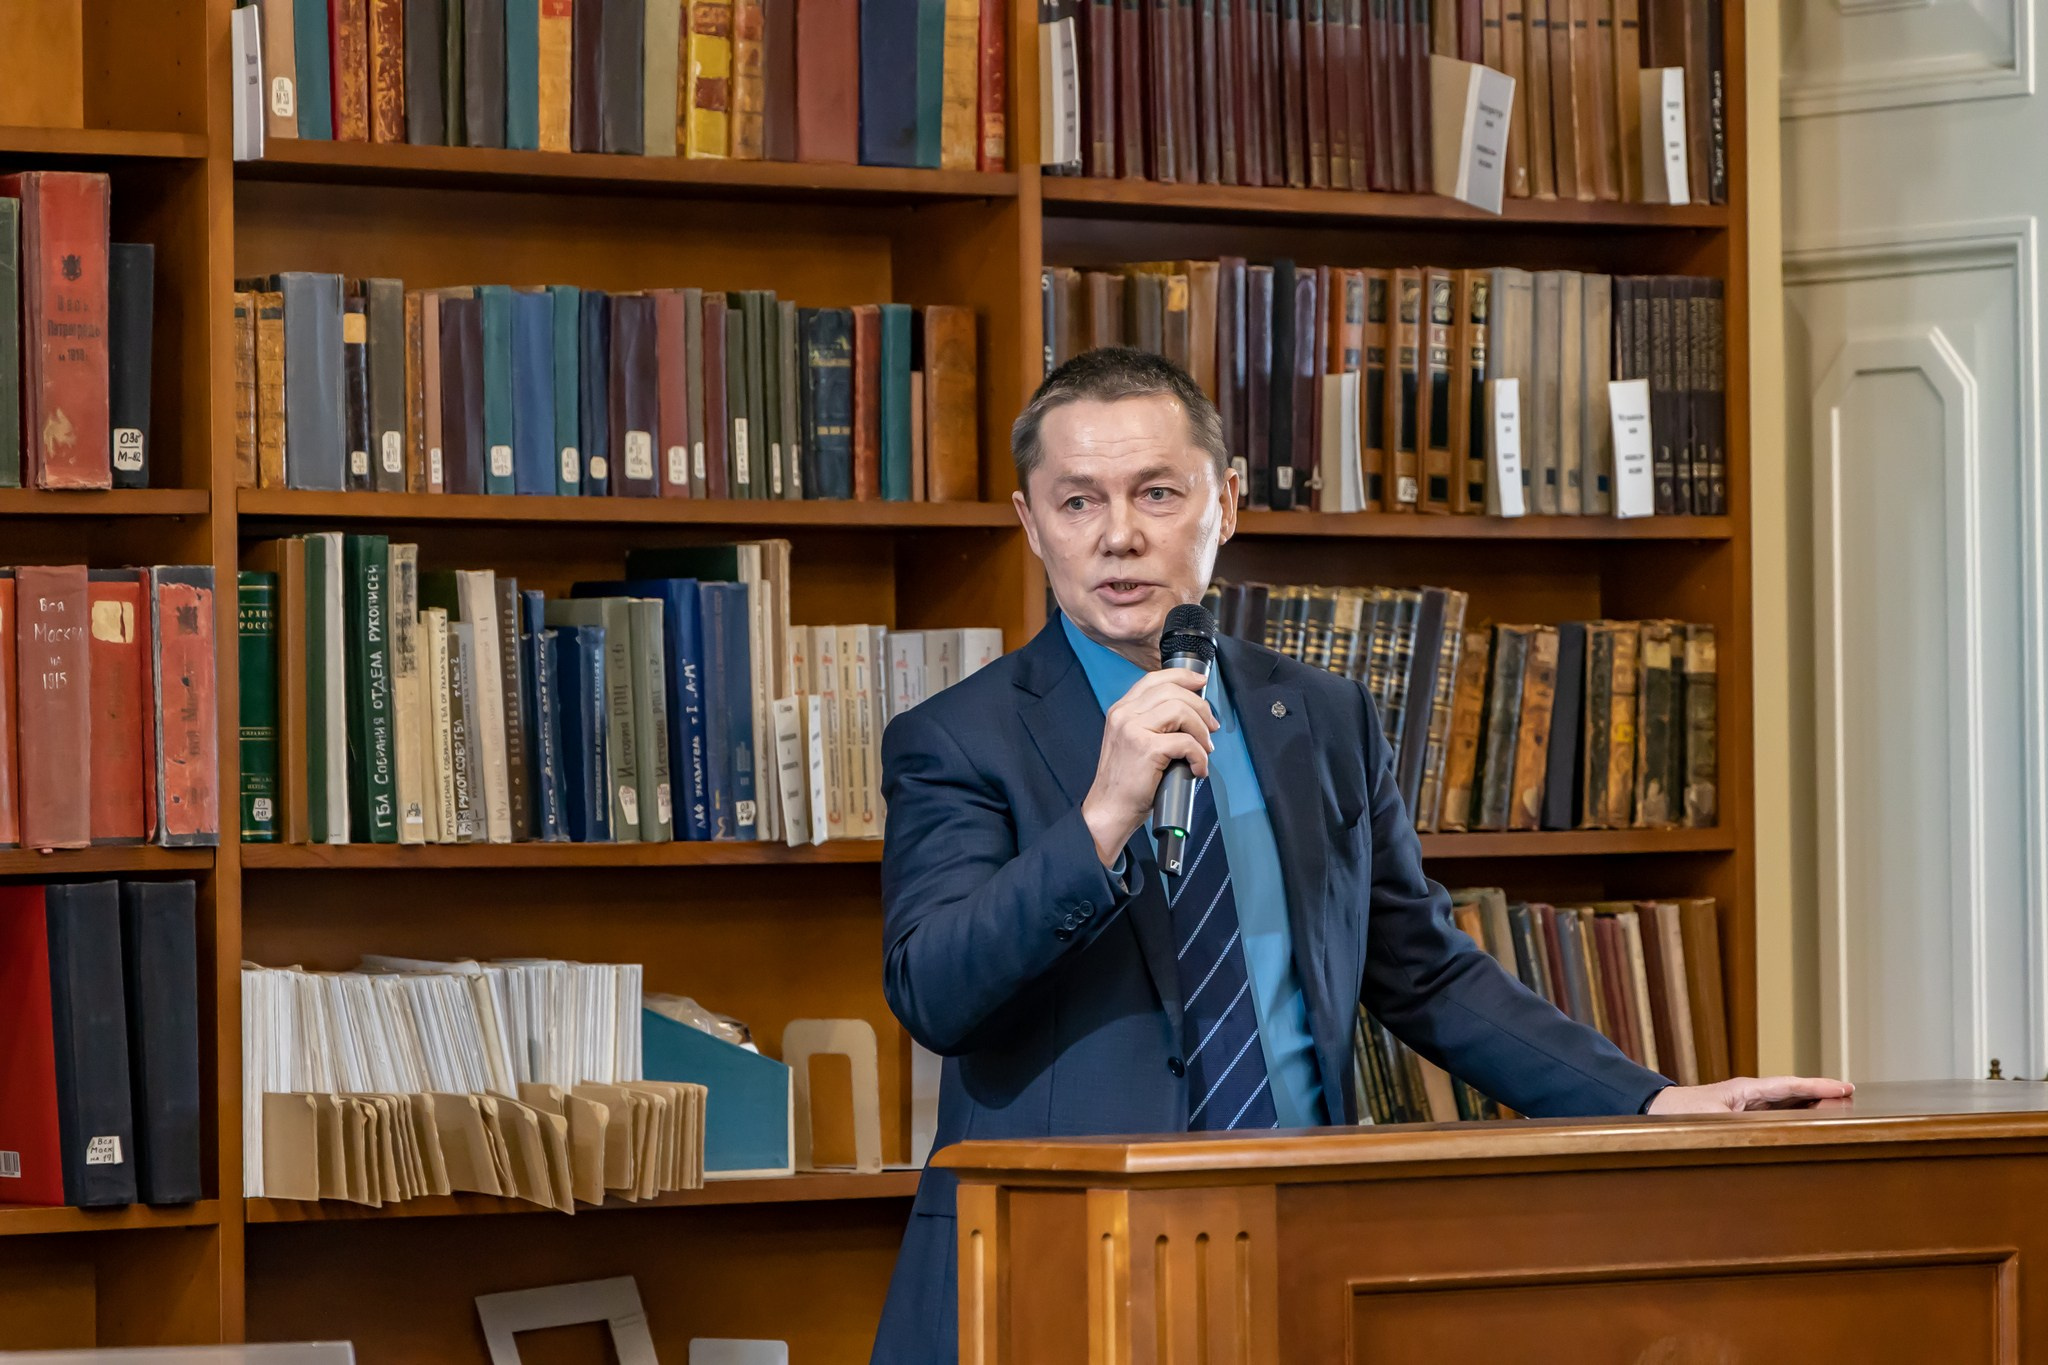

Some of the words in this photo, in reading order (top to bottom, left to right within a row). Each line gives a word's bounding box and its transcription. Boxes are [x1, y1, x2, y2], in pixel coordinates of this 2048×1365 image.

[364, 564, 381, 642] РУКОПИСЕЙ
[616, 722, 635, 779] История
[375, 794, 391, 828] ГБЛ
